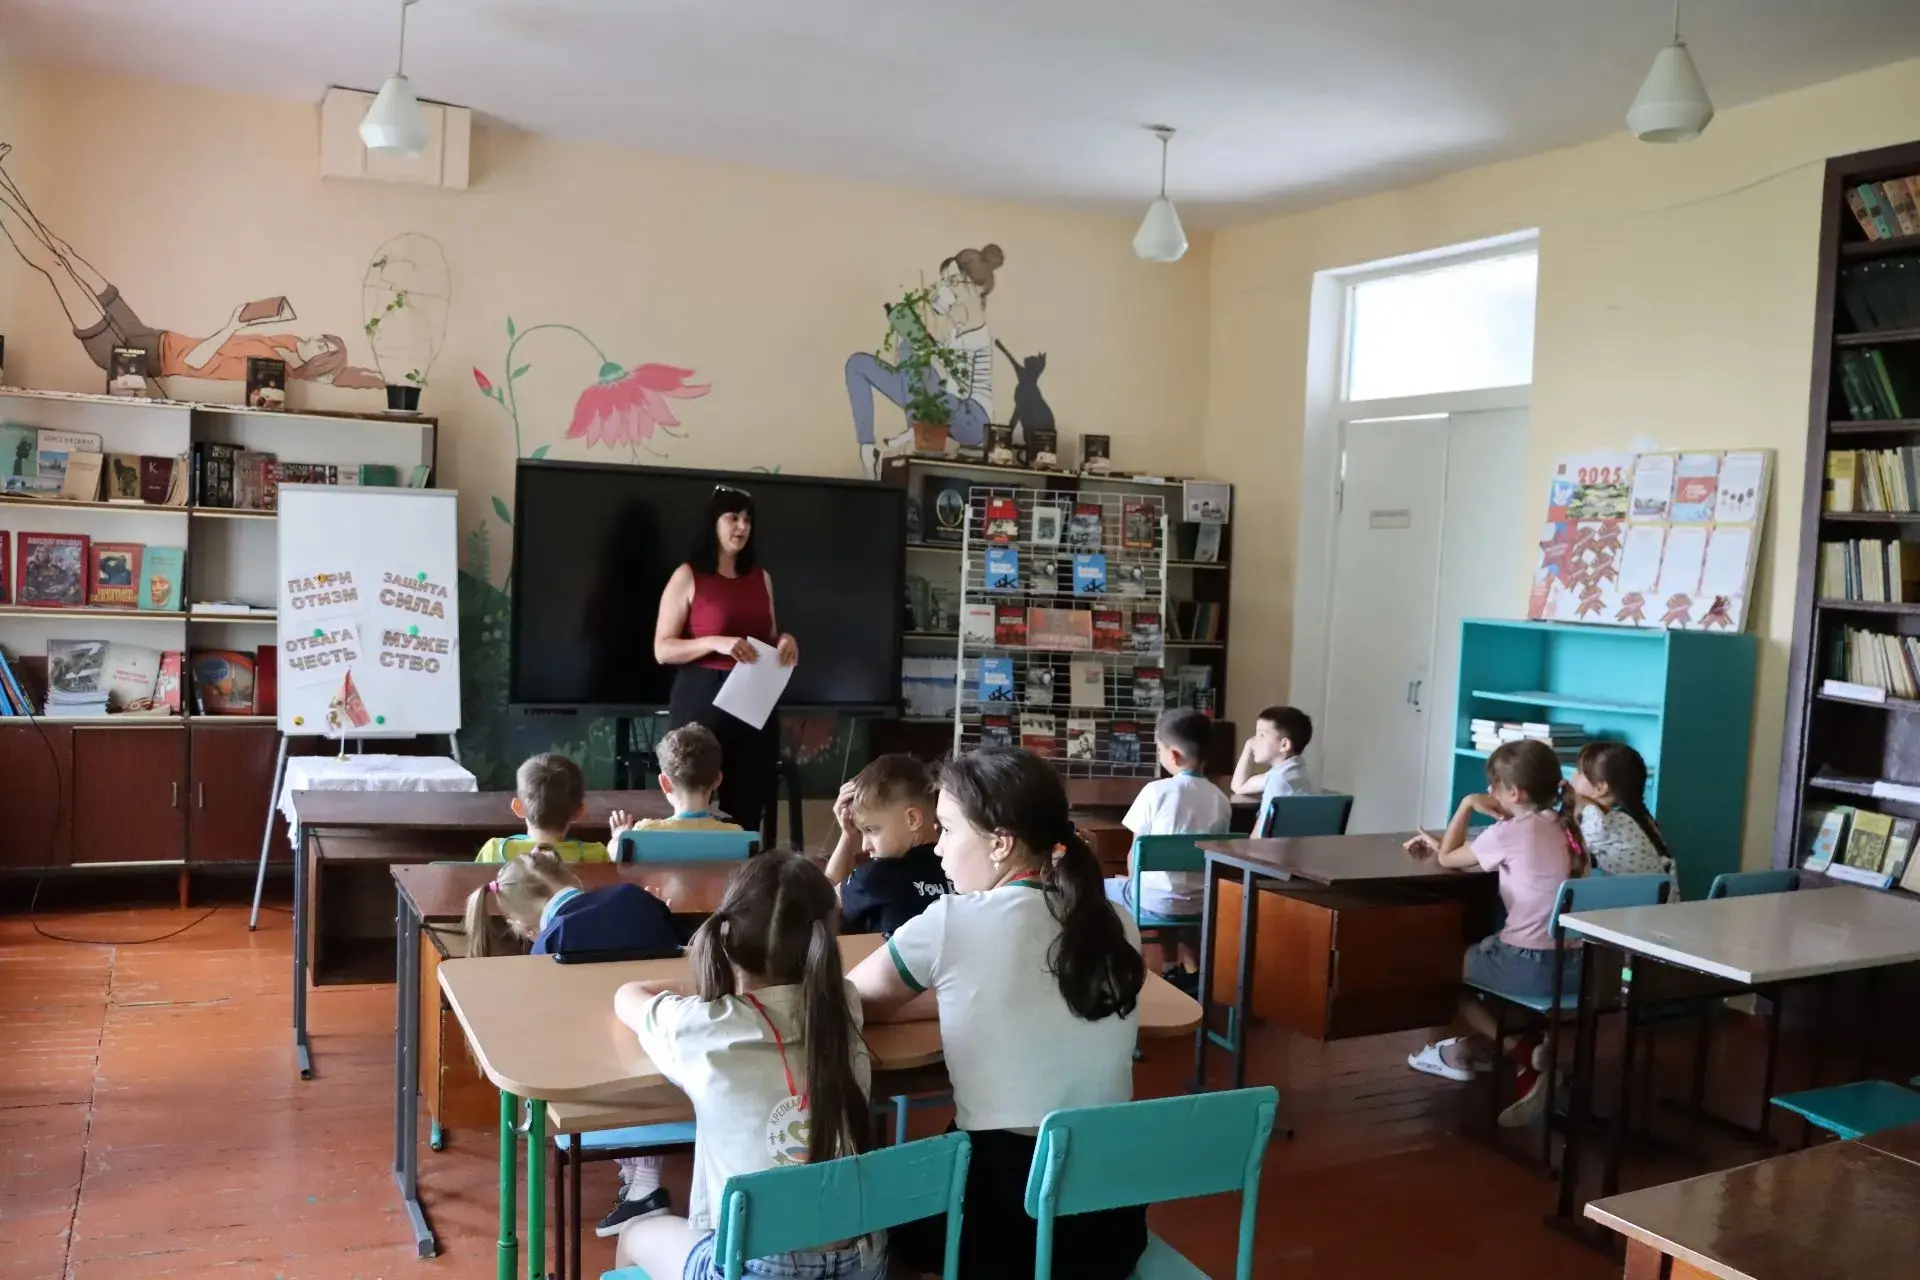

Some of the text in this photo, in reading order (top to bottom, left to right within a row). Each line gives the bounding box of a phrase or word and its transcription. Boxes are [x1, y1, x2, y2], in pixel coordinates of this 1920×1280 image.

[1578, 466, 1622, 485] 2025
[383, 572, 448, 598] ЗАЩИТА
[291, 587, 358, 610] ОТИЗМ
[379, 588, 445, 620] СИЛА
[285, 628, 354, 652] ОТВАГА
[382, 630, 450, 654] МУЖЕ
[289, 647, 357, 671] ЧЕСТЬ
[380, 651, 441, 673] СТВО
